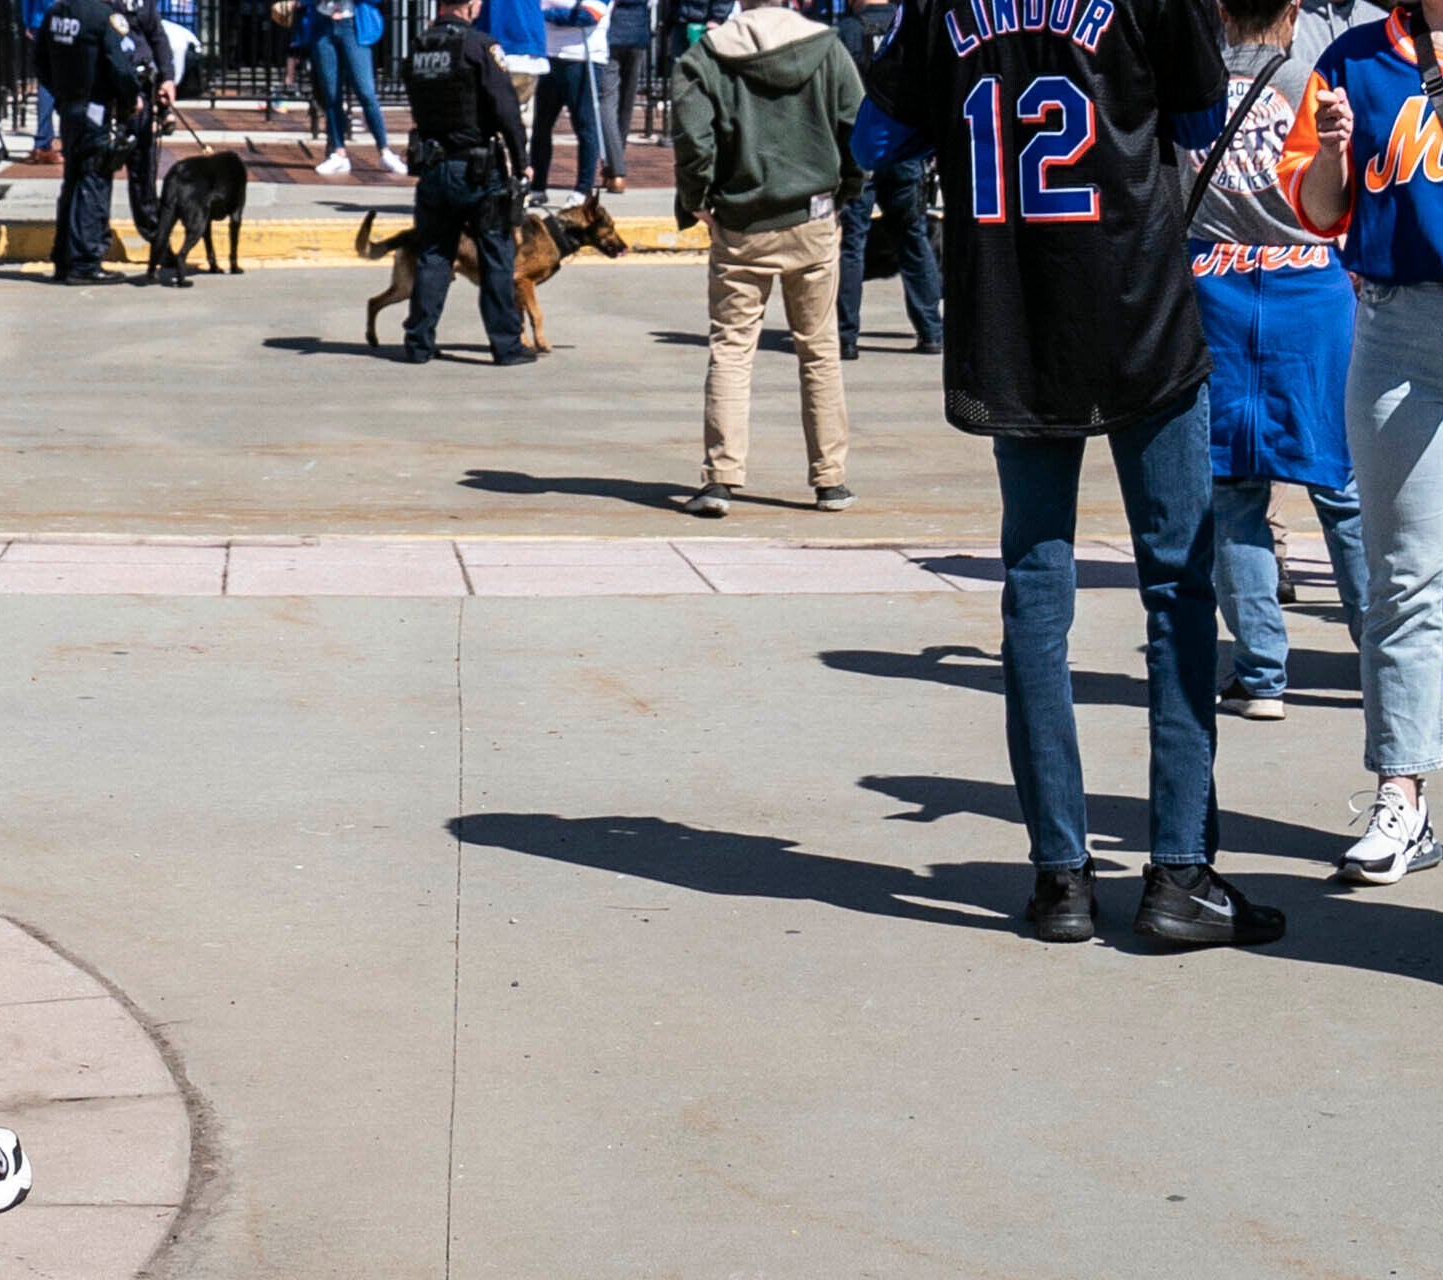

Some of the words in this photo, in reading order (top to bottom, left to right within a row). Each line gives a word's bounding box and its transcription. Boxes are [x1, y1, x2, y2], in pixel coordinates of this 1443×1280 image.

[50, 15, 81, 36] NYPD
[413, 51, 451, 70] NYPD
[963, 76, 1101, 223] 12
